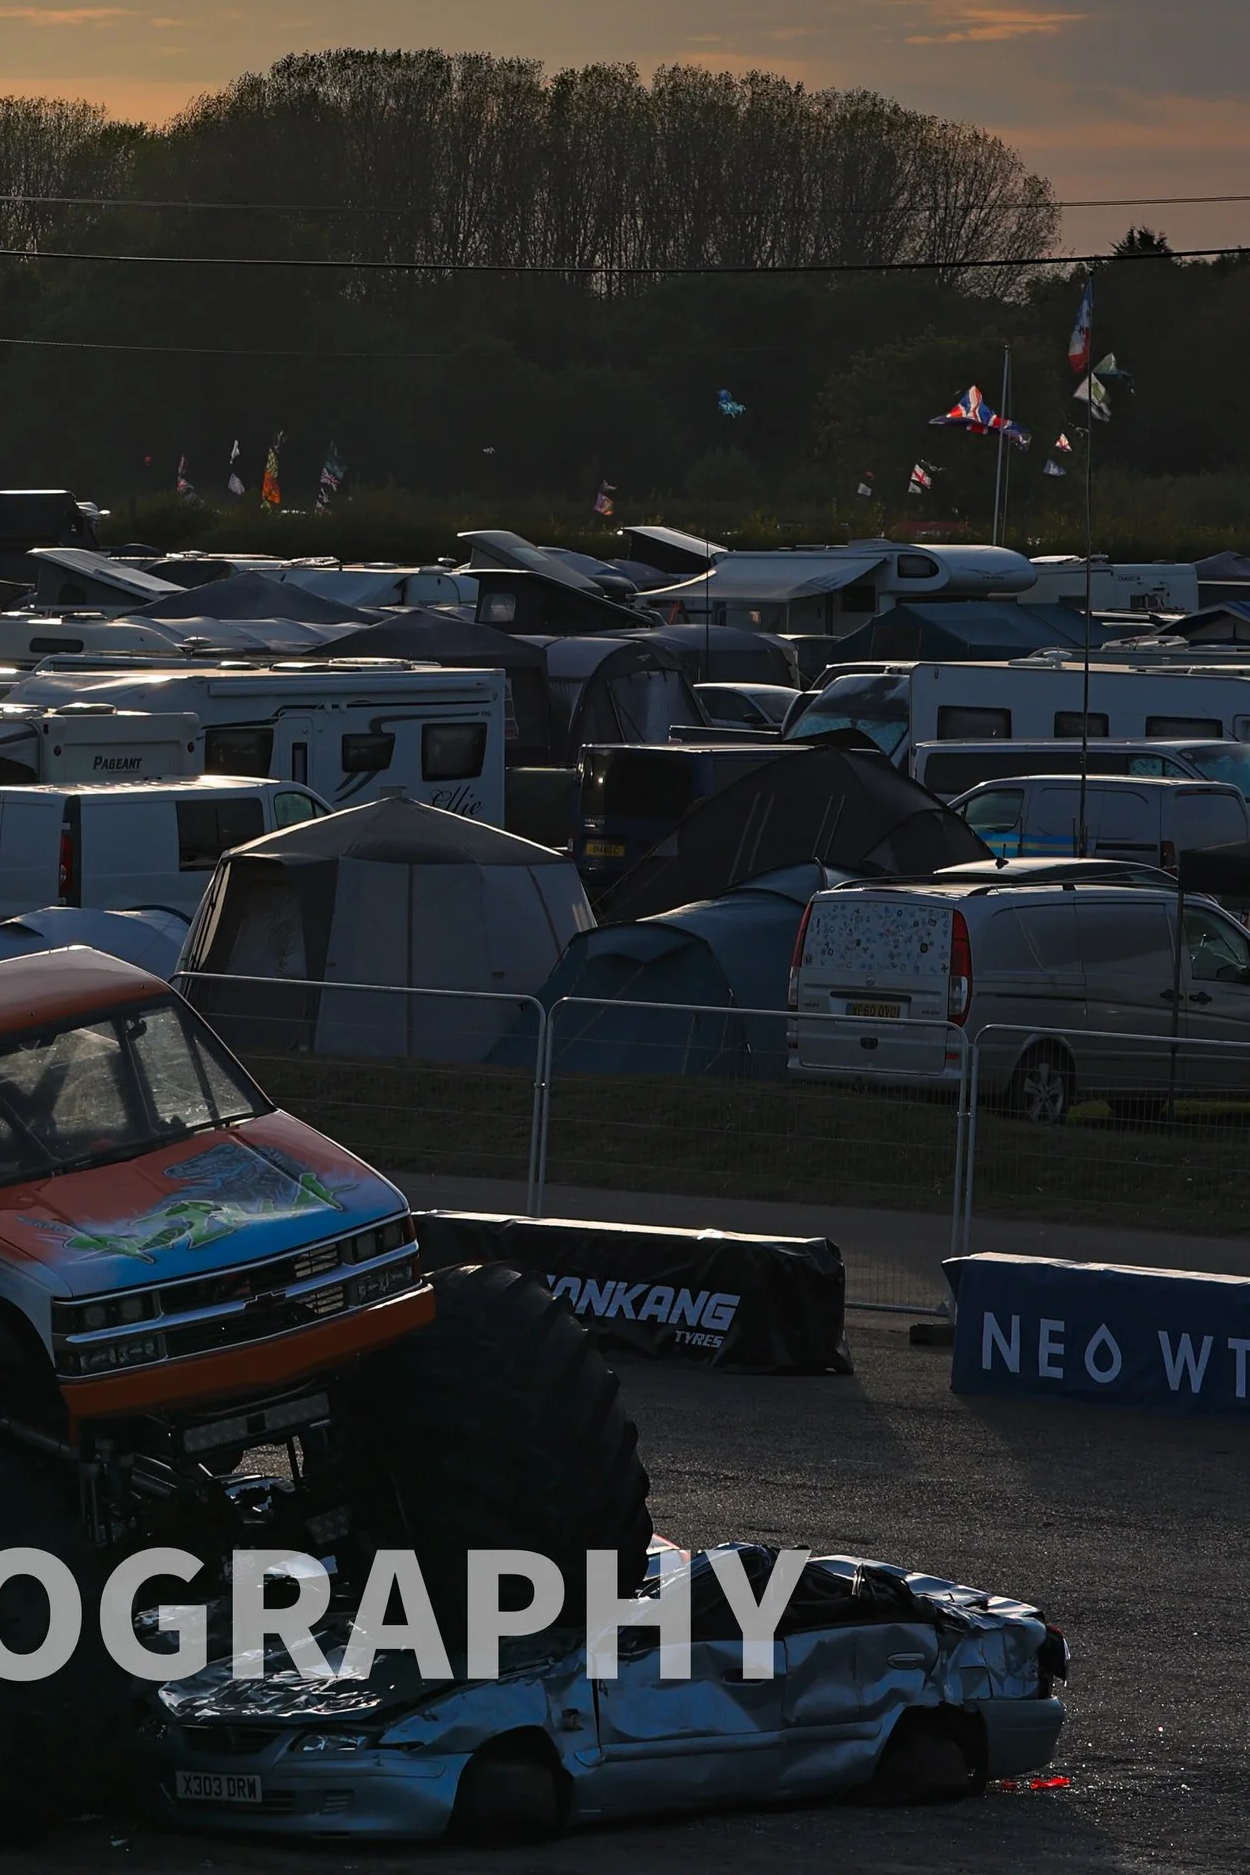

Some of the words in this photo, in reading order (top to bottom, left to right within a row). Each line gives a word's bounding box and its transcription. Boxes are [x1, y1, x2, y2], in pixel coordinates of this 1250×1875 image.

[93, 756, 143, 770] PAGEANT
[673, 1330, 726, 1349] TYRES
[182, 1773, 223, 1797] X303
[226, 1776, 258, 1799] DRW
